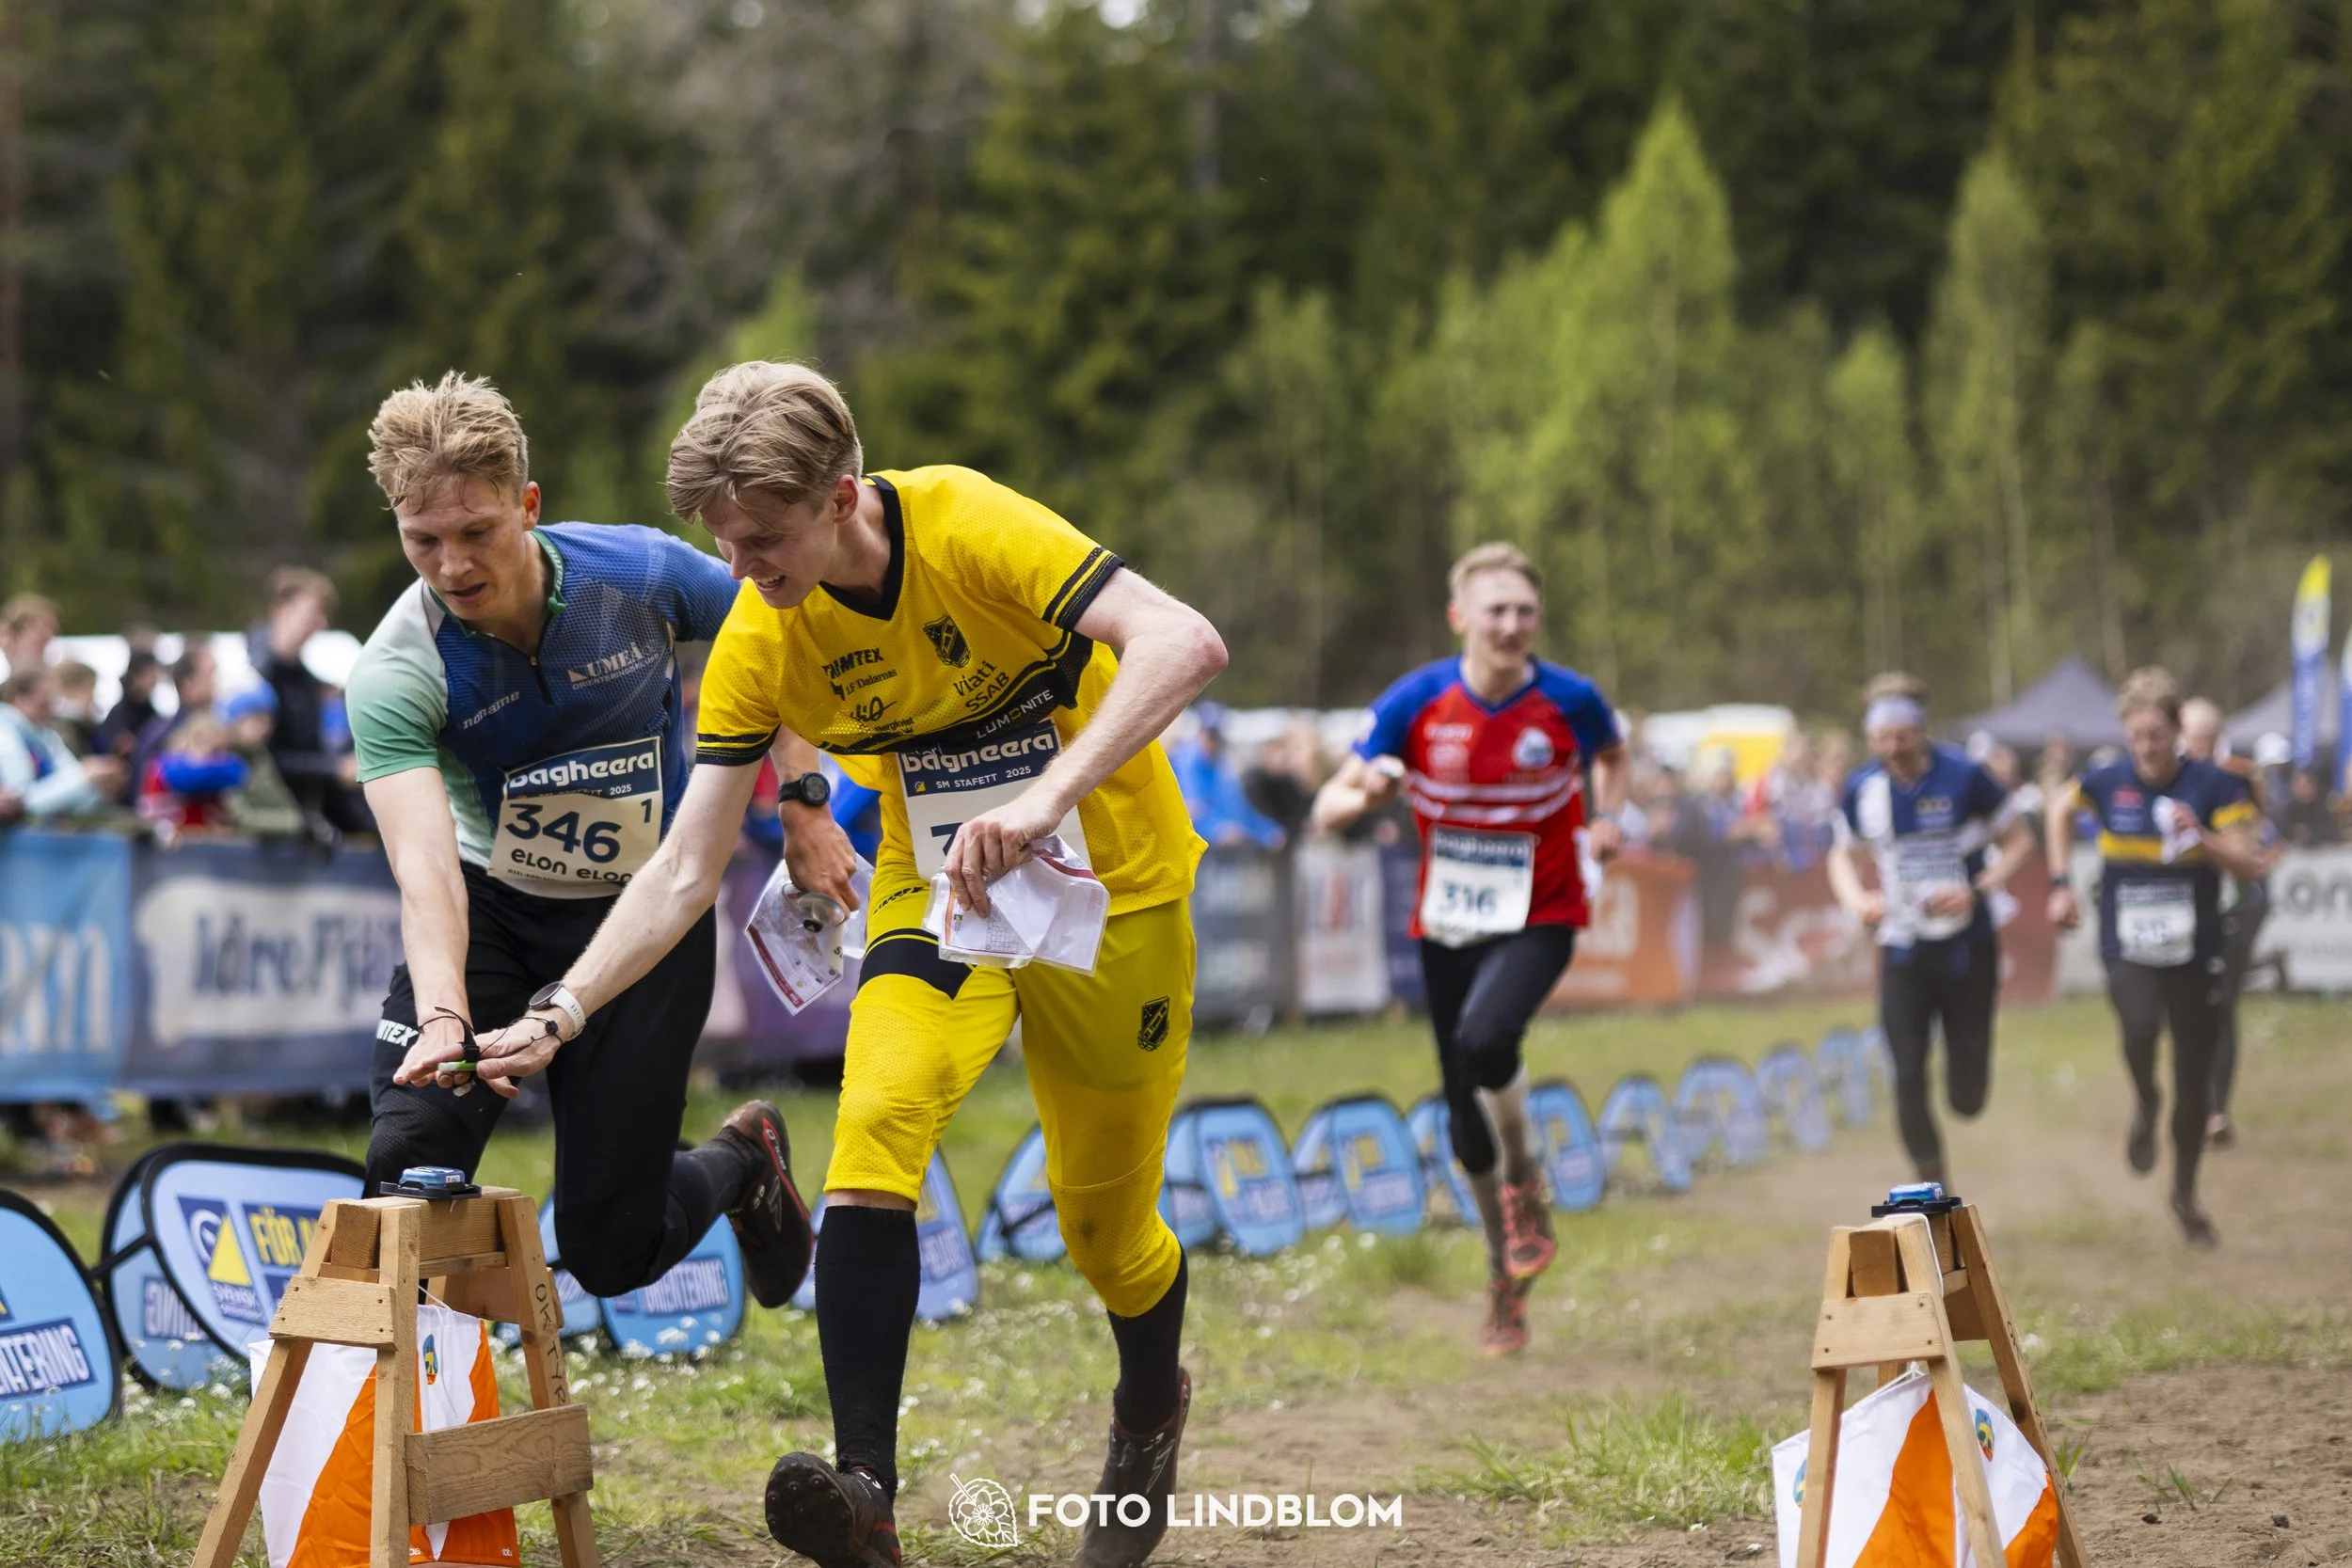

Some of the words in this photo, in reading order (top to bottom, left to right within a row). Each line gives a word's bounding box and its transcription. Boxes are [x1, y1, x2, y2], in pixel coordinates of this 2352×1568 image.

[965, 672, 1009, 712] SSAB
[463, 691, 520, 730] noname
[509, 752, 655, 787] bagheera
[936, 781, 950, 789] SM
[954, 773, 997, 788] STAFETT
[1006, 766, 1032, 778] 2025
[610, 784, 632, 796] 2025
[641, 798, 653, 824] 1
[504, 803, 623, 864] 346
[1439, 879, 1499, 916] 316
